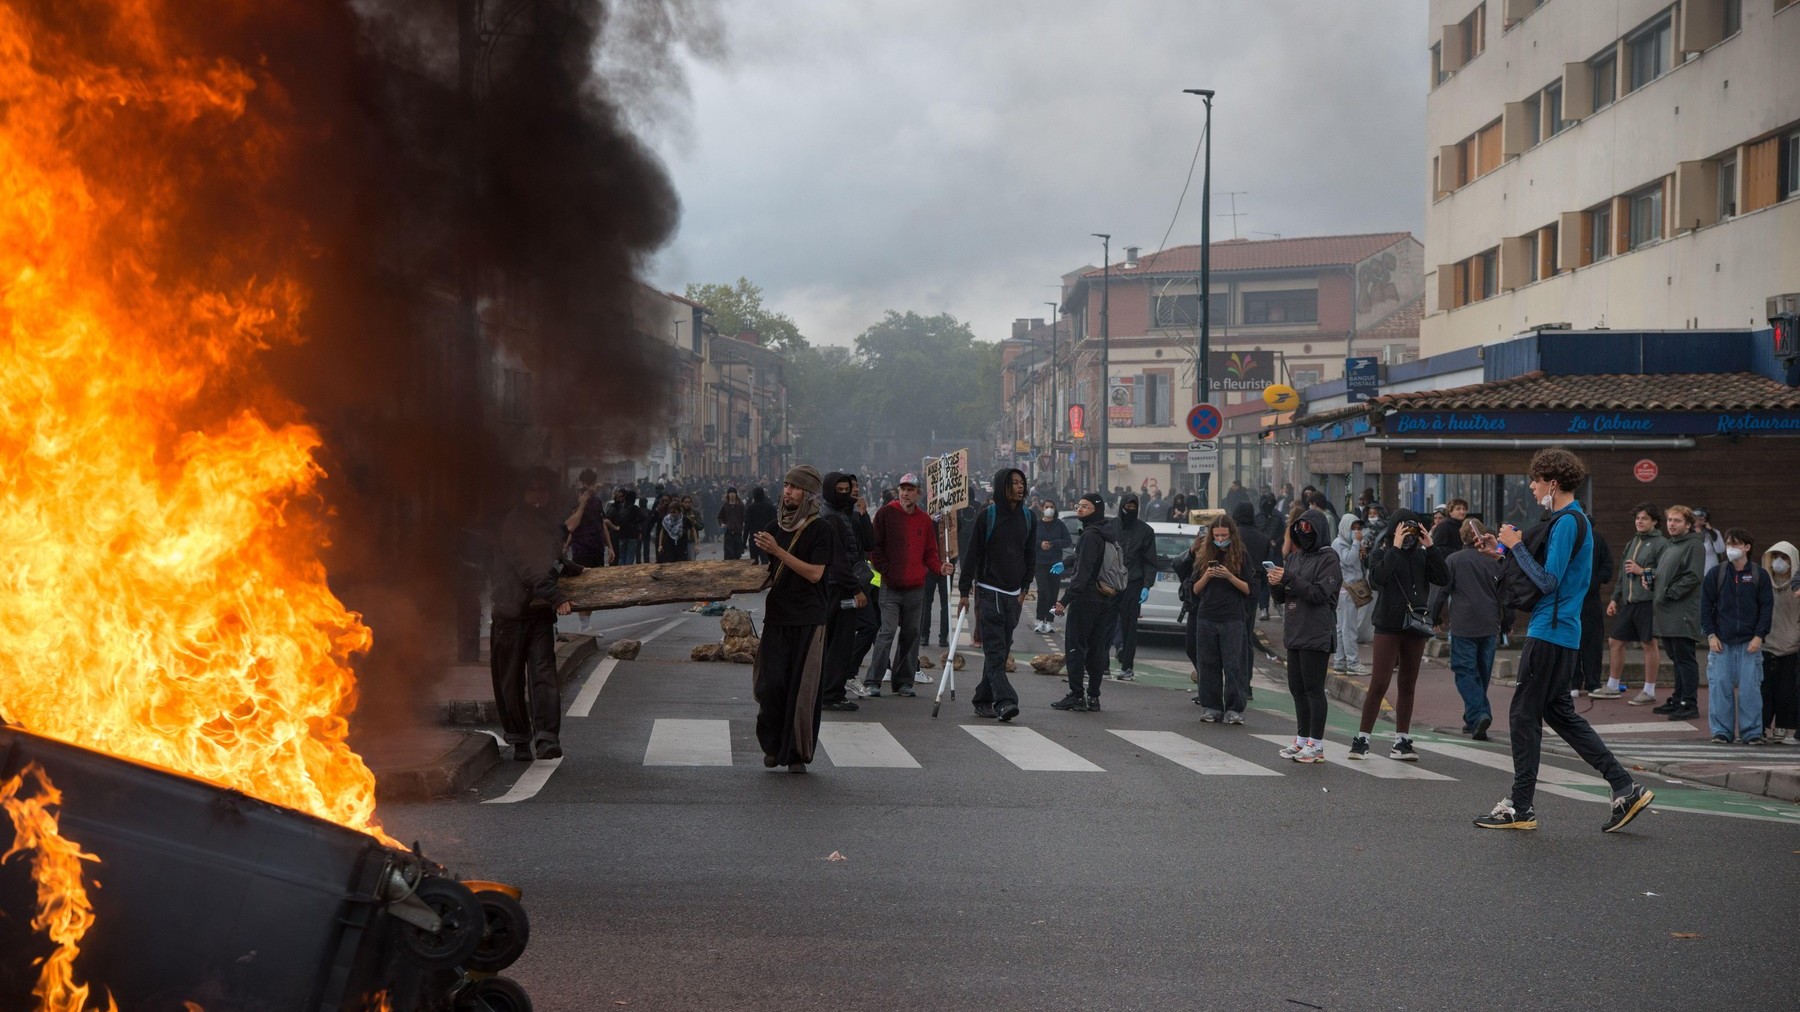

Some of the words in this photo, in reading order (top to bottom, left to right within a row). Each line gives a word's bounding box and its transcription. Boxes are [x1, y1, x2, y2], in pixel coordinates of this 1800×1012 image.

[1210, 379, 1221, 390] le
[1223, 378, 1272, 390] fleuriste
[1397, 414, 1430, 433] Bar
[1432, 414, 1445, 430] à
[1567, 415, 1590, 433] La
[1593, 413, 1654, 432] Cabane
